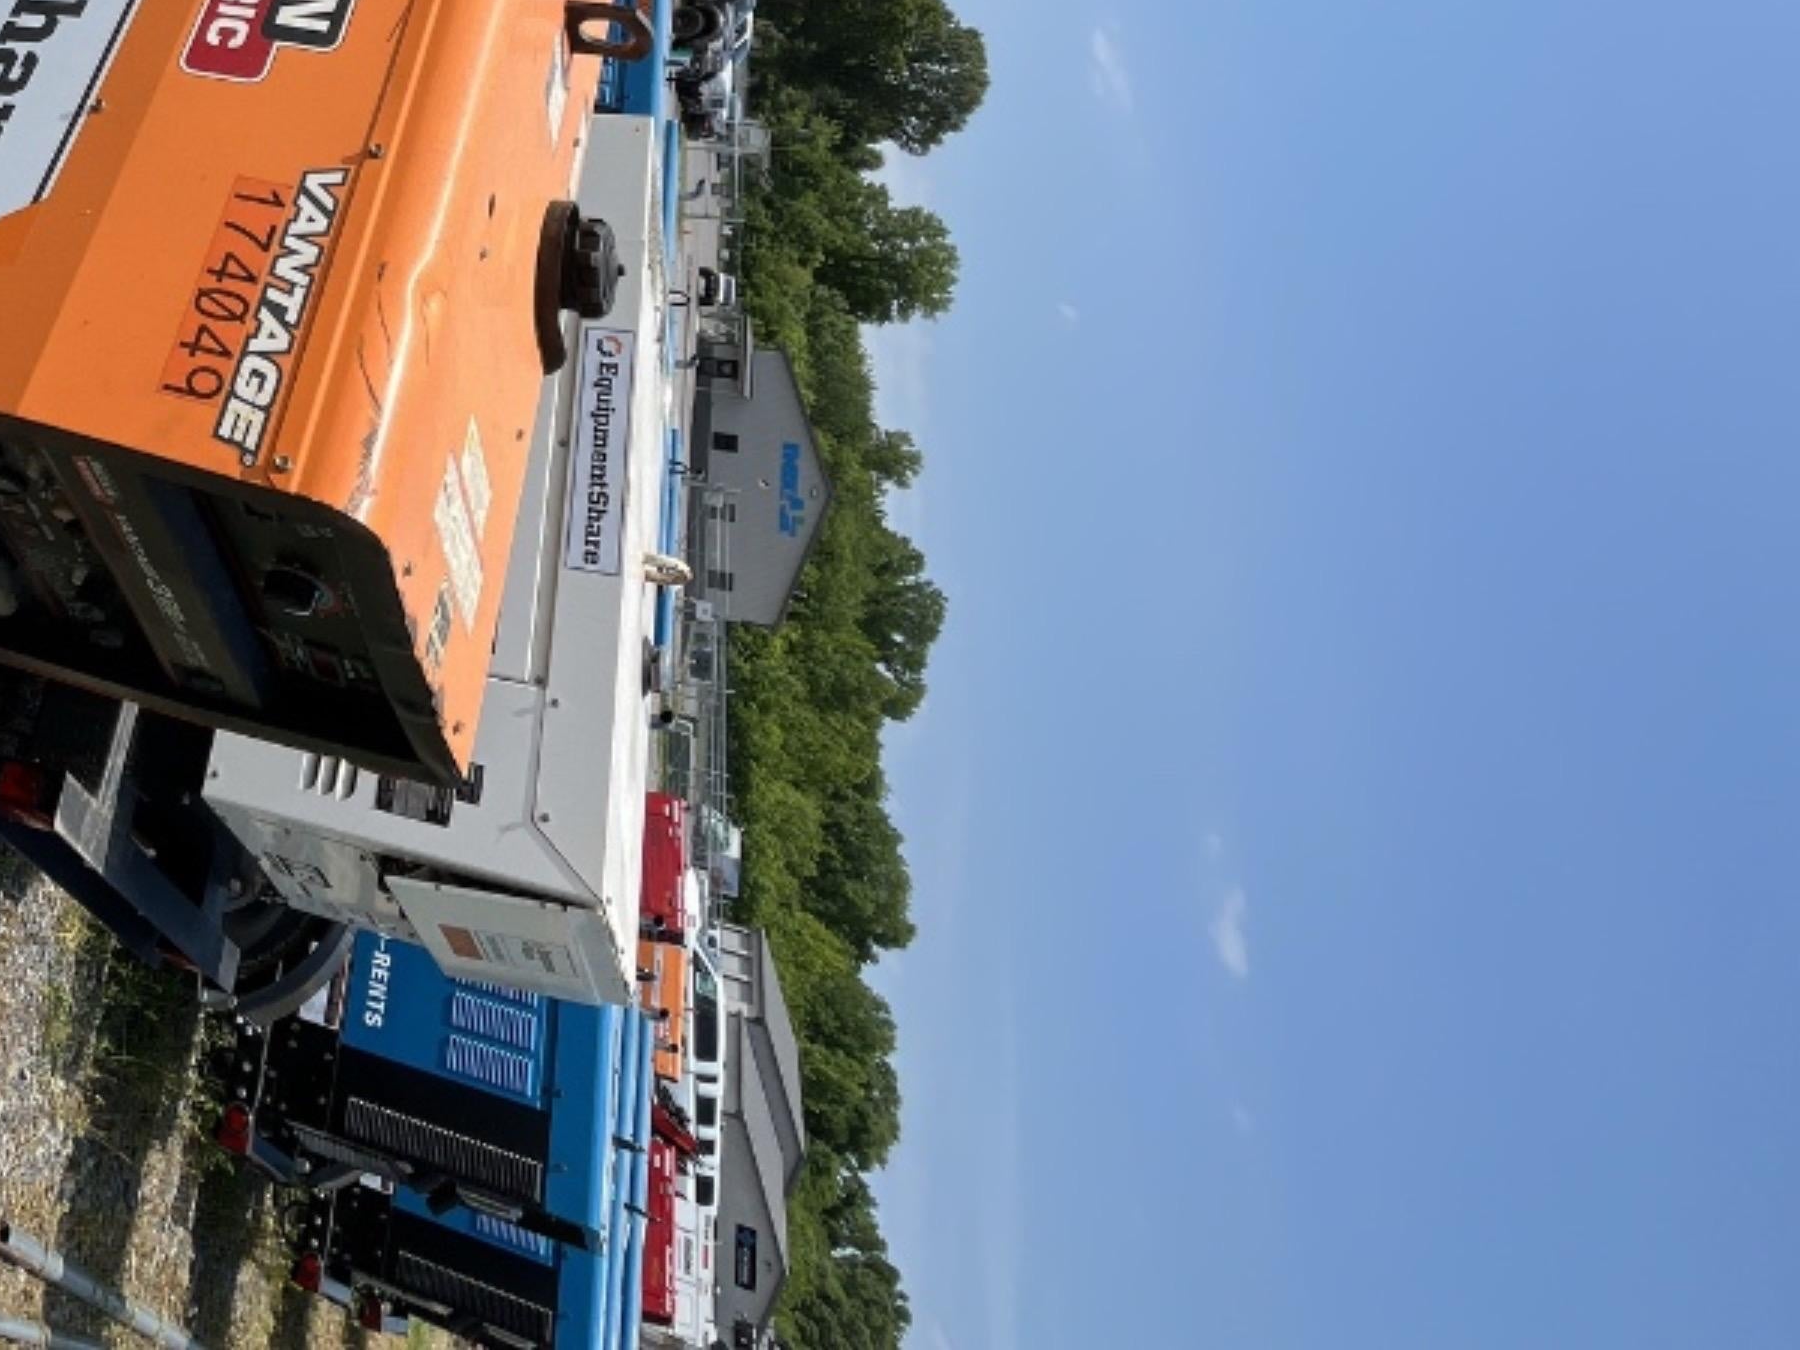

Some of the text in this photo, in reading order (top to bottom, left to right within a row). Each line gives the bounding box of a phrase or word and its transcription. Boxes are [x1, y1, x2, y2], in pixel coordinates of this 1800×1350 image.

[161, 190, 286, 400] 174049
[215, 168, 350, 454] VANTAGE
[583, 361, 619, 566] EquipmentShare
